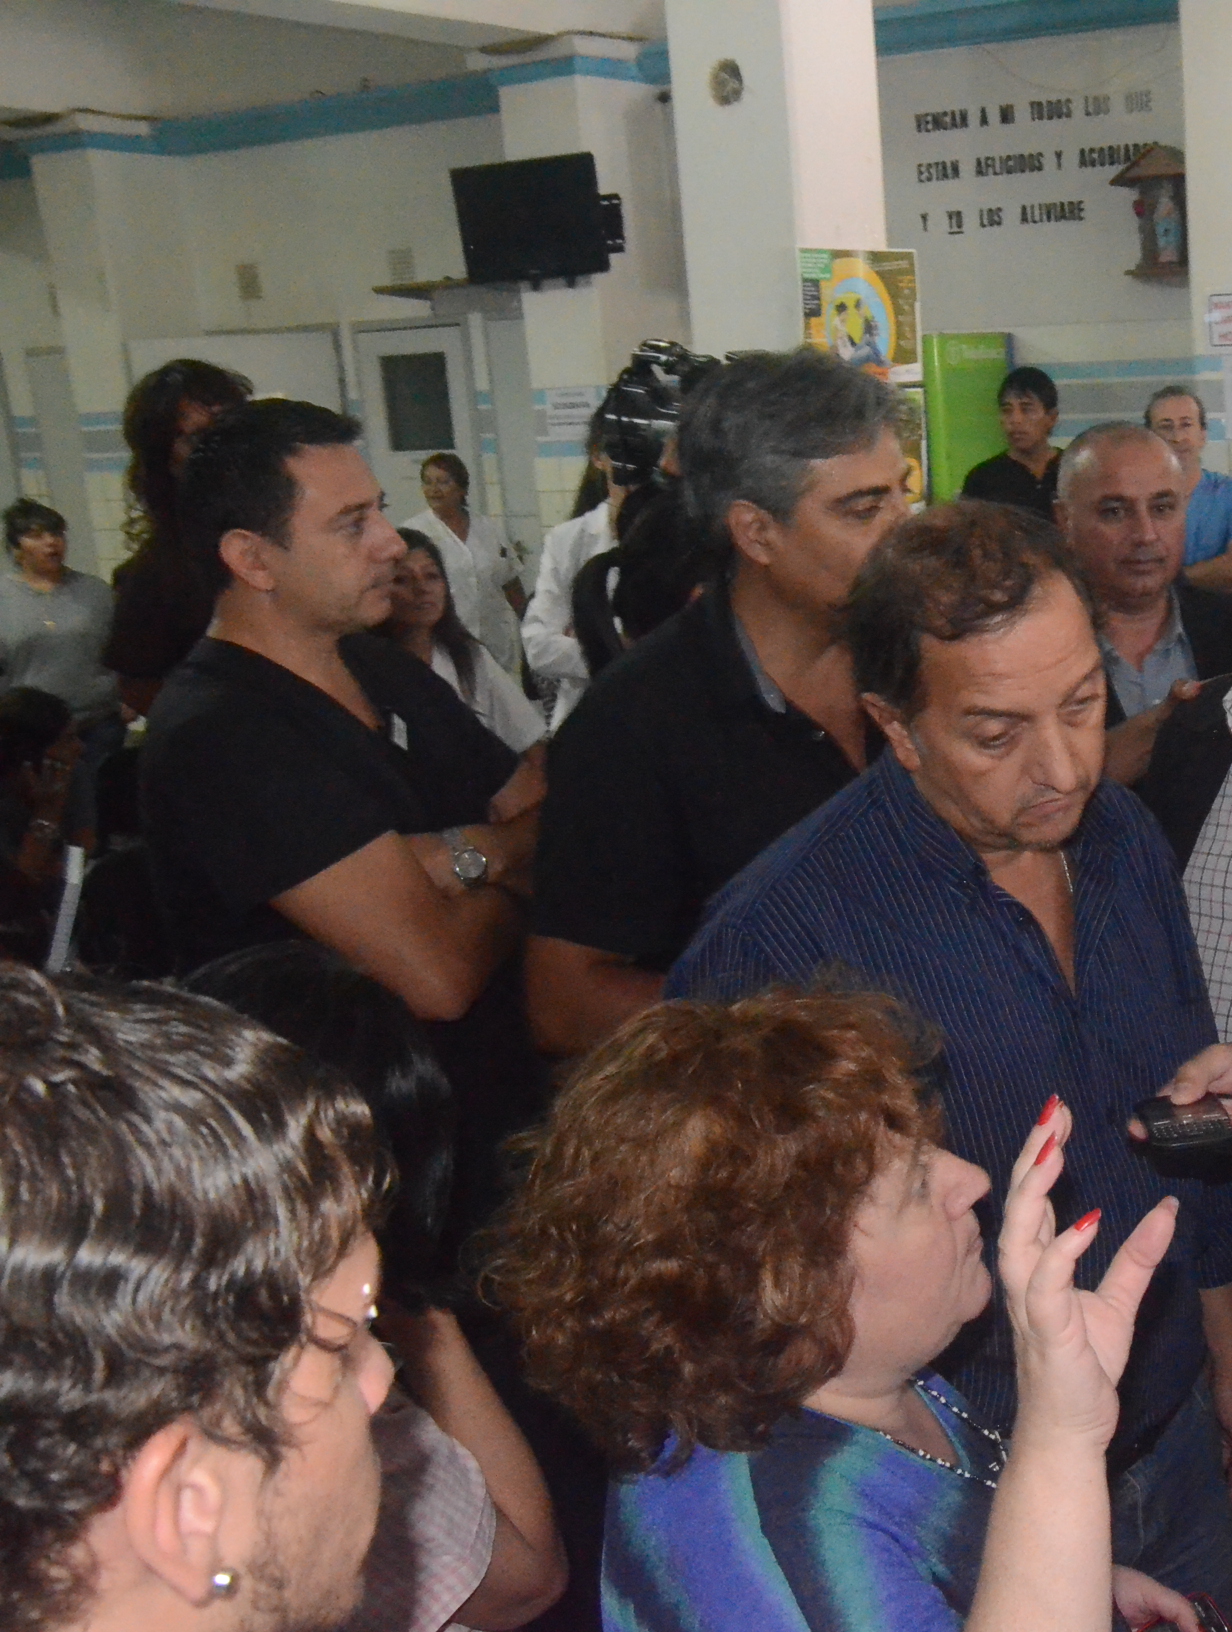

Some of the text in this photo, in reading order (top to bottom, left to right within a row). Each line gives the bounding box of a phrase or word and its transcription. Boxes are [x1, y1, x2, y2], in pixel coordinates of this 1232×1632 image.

[915, 109, 968, 132] VENGAN
[979, 106, 989, 127] A
[1029, 99, 1073, 121] TODOS
[917, 159, 960, 183] ESTAN
[975, 152, 1044, 177] AFLIGIDOS
[1054, 150, 1064, 171] Y
[920, 200, 1085, 233] Y YO LOS ALIVIARE
